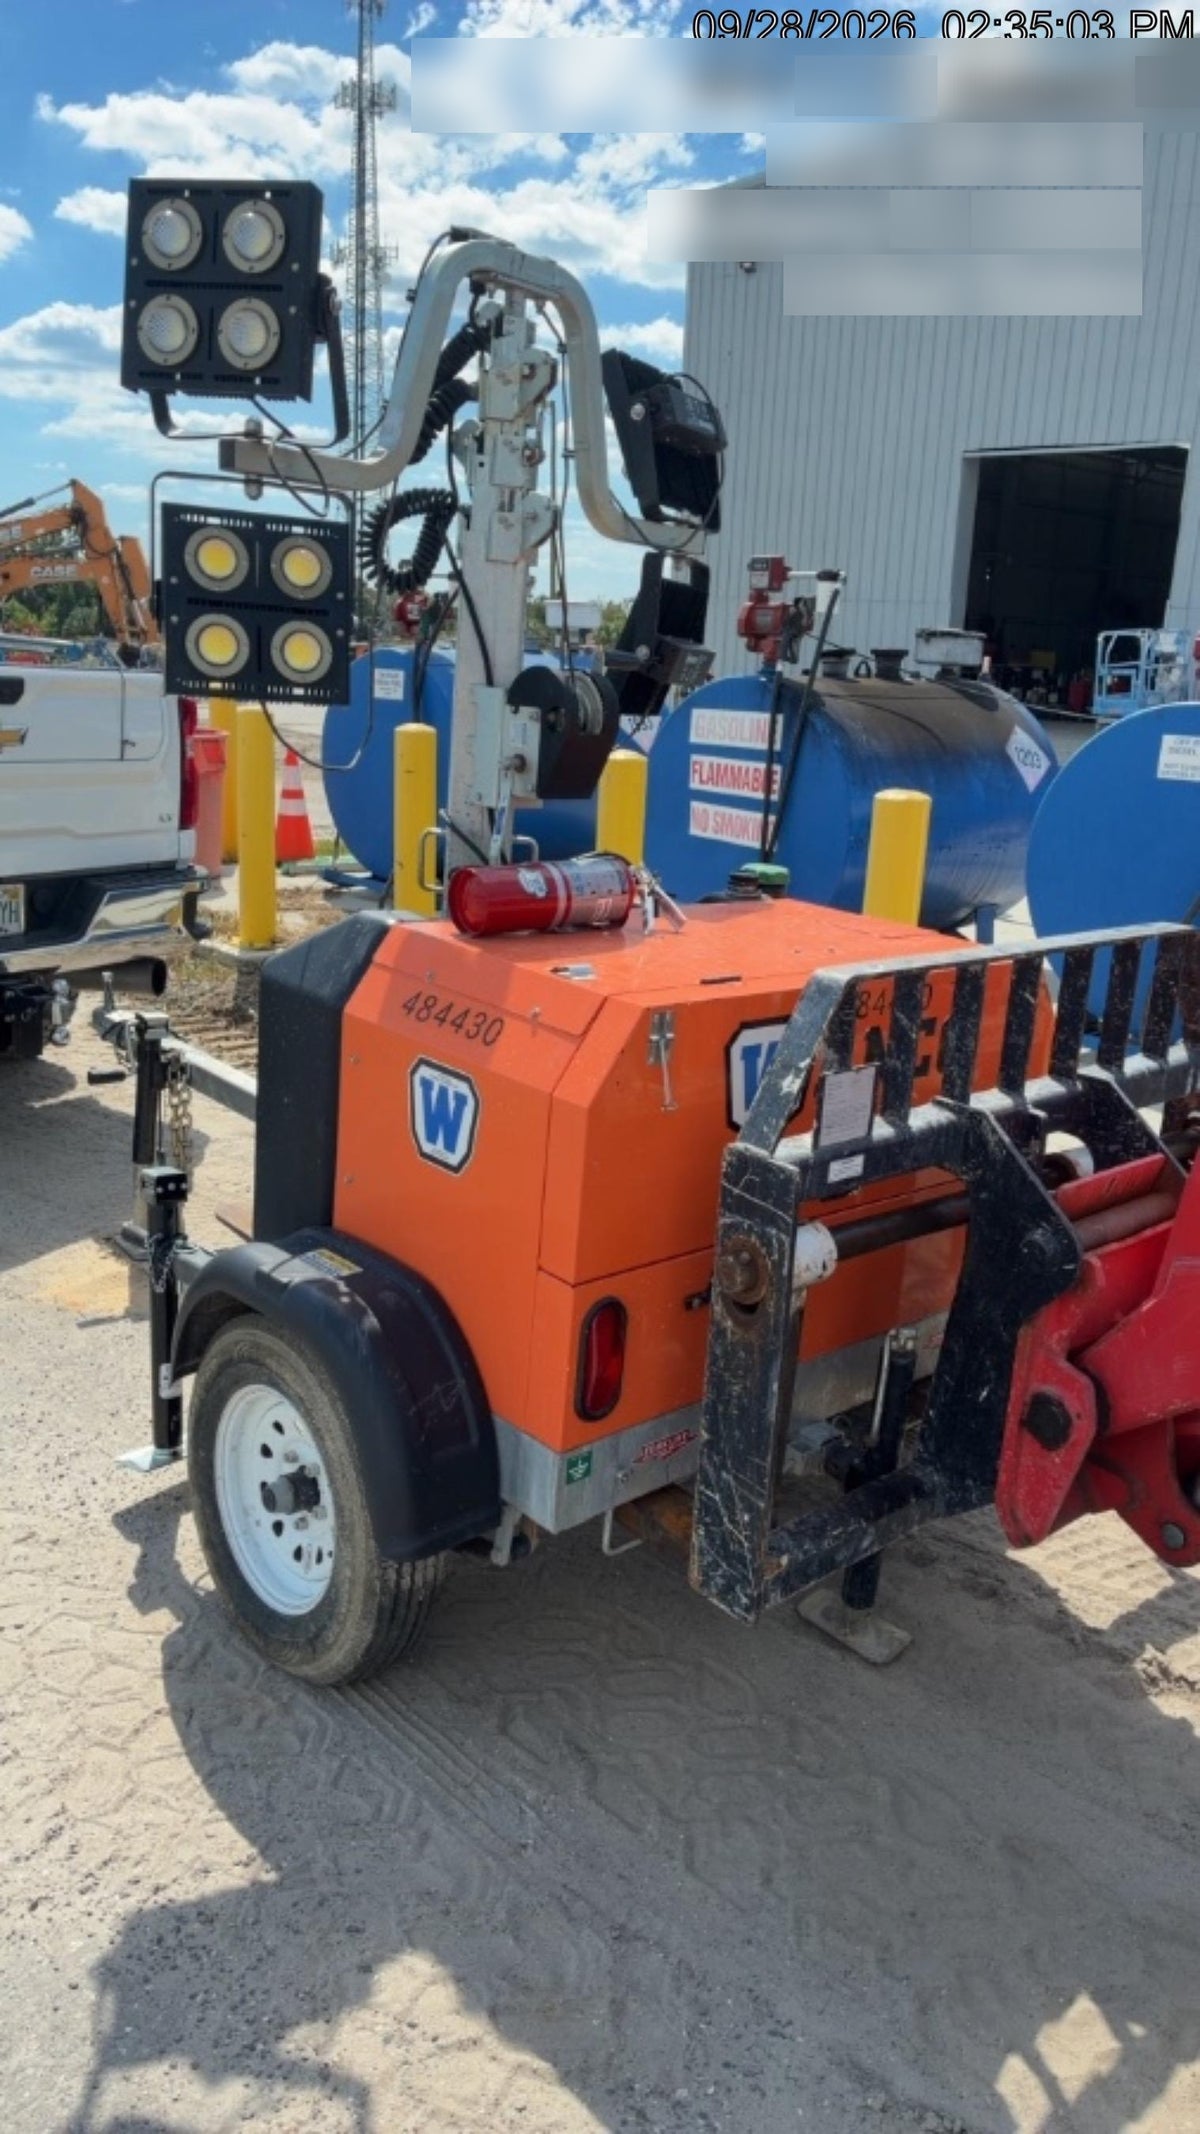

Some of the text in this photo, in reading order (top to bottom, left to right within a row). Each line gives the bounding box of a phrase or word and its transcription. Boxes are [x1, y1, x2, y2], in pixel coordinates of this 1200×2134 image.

[30, 563, 77, 578] CASE
[694, 713, 773, 746] GASOLIN
[693, 806, 710, 834] NO
[402, 990, 505, 1047] 484430
[420, 1075, 468, 1155] W
